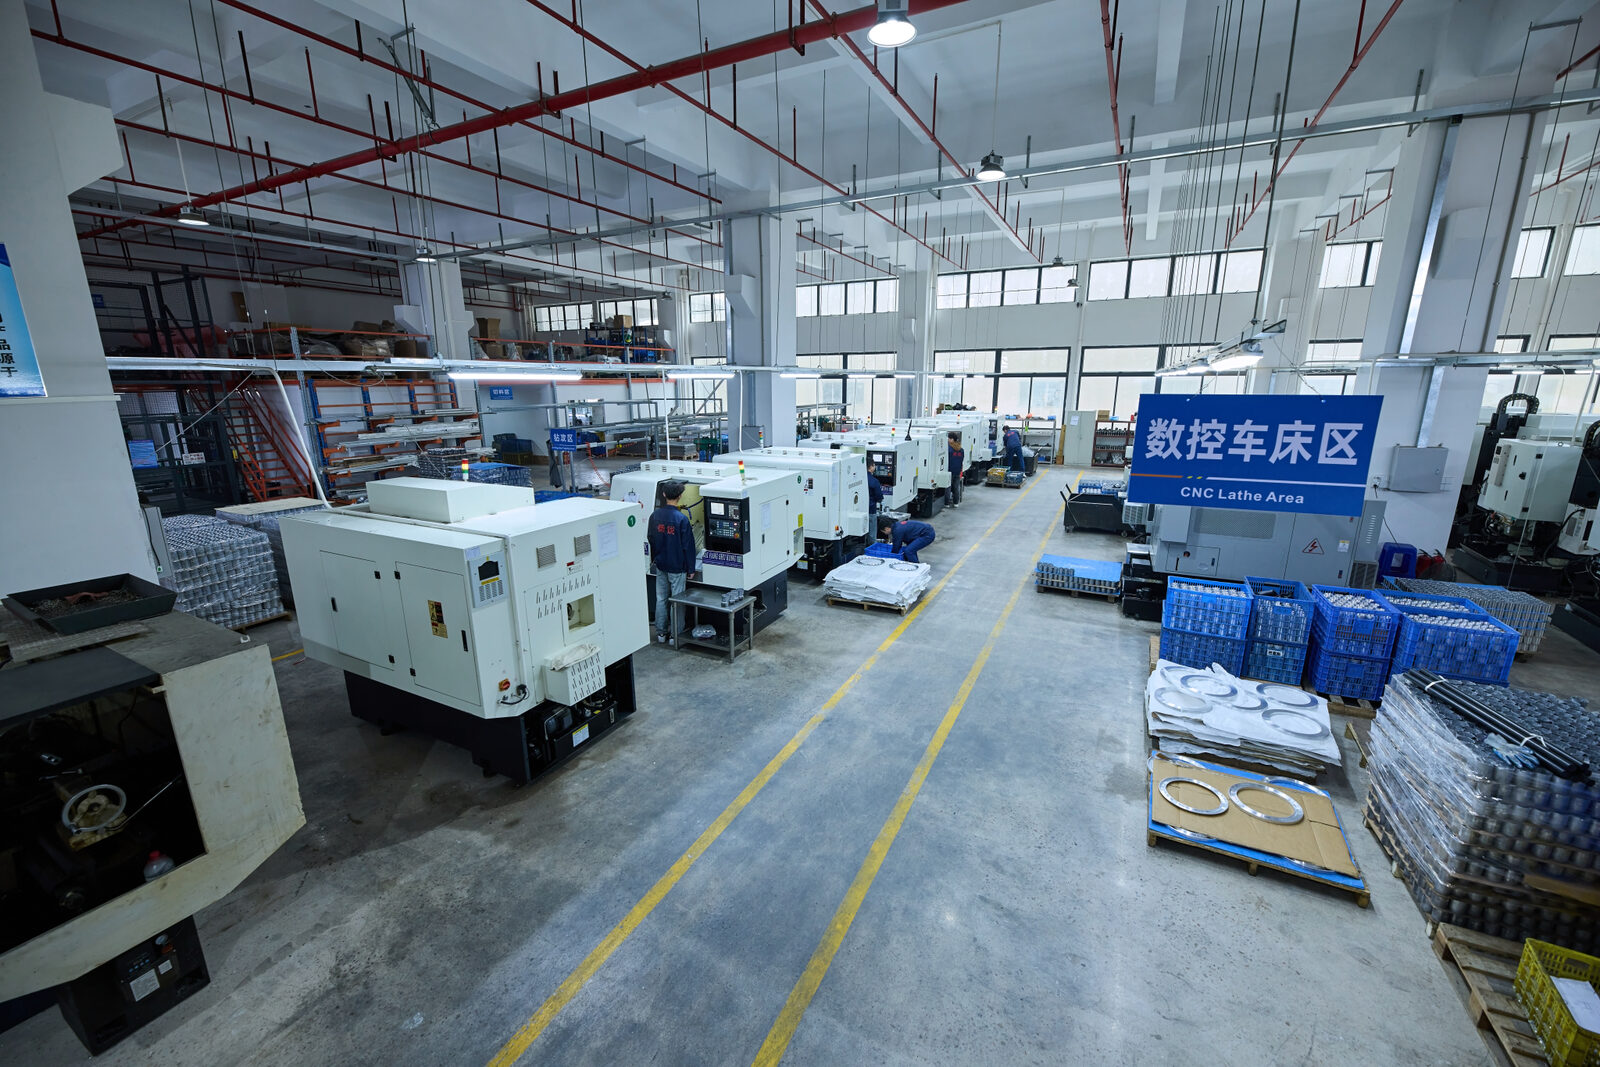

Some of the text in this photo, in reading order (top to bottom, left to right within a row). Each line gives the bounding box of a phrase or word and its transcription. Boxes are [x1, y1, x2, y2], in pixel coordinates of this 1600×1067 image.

[1145, 417, 1364, 466] 数控车床区
[1180, 486, 1305, 504] CNC Lathe Area
